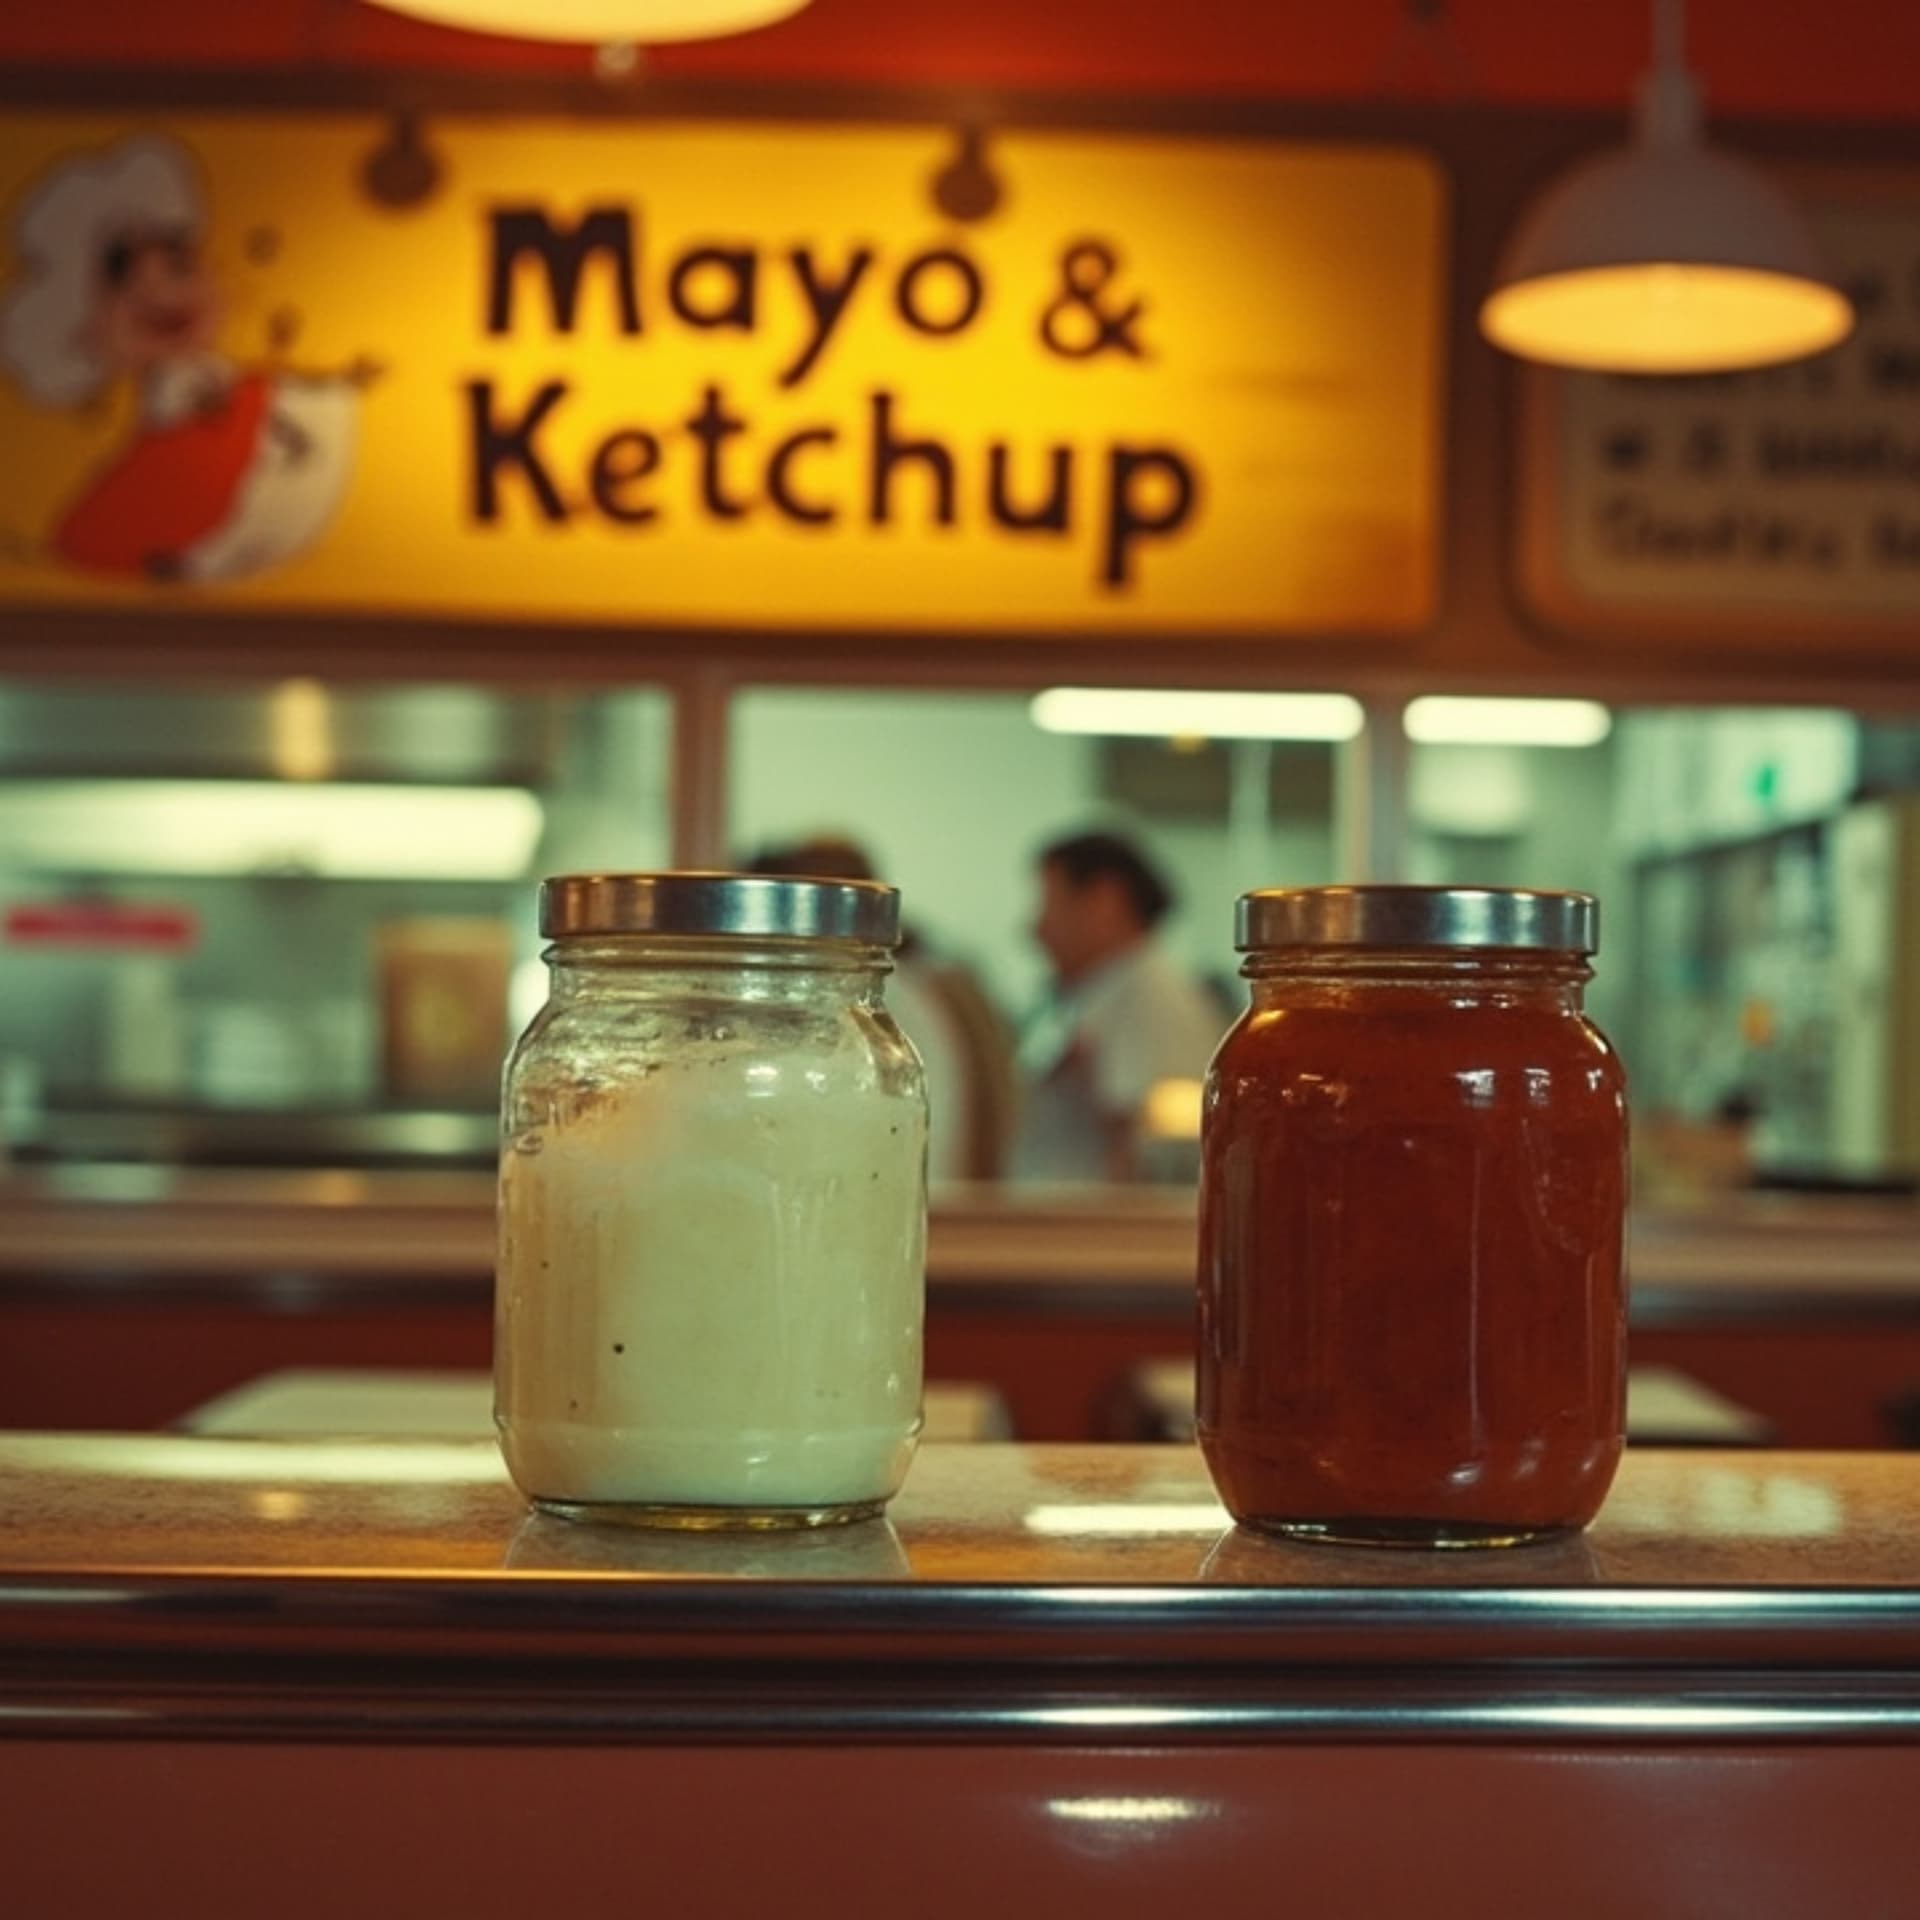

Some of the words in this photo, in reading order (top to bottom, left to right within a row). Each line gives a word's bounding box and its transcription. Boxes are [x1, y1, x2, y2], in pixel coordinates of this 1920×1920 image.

[484, 205, 984, 389] Mayo
[1036, 236, 1152, 362] &
[466, 378, 1201, 590] Ketchup
